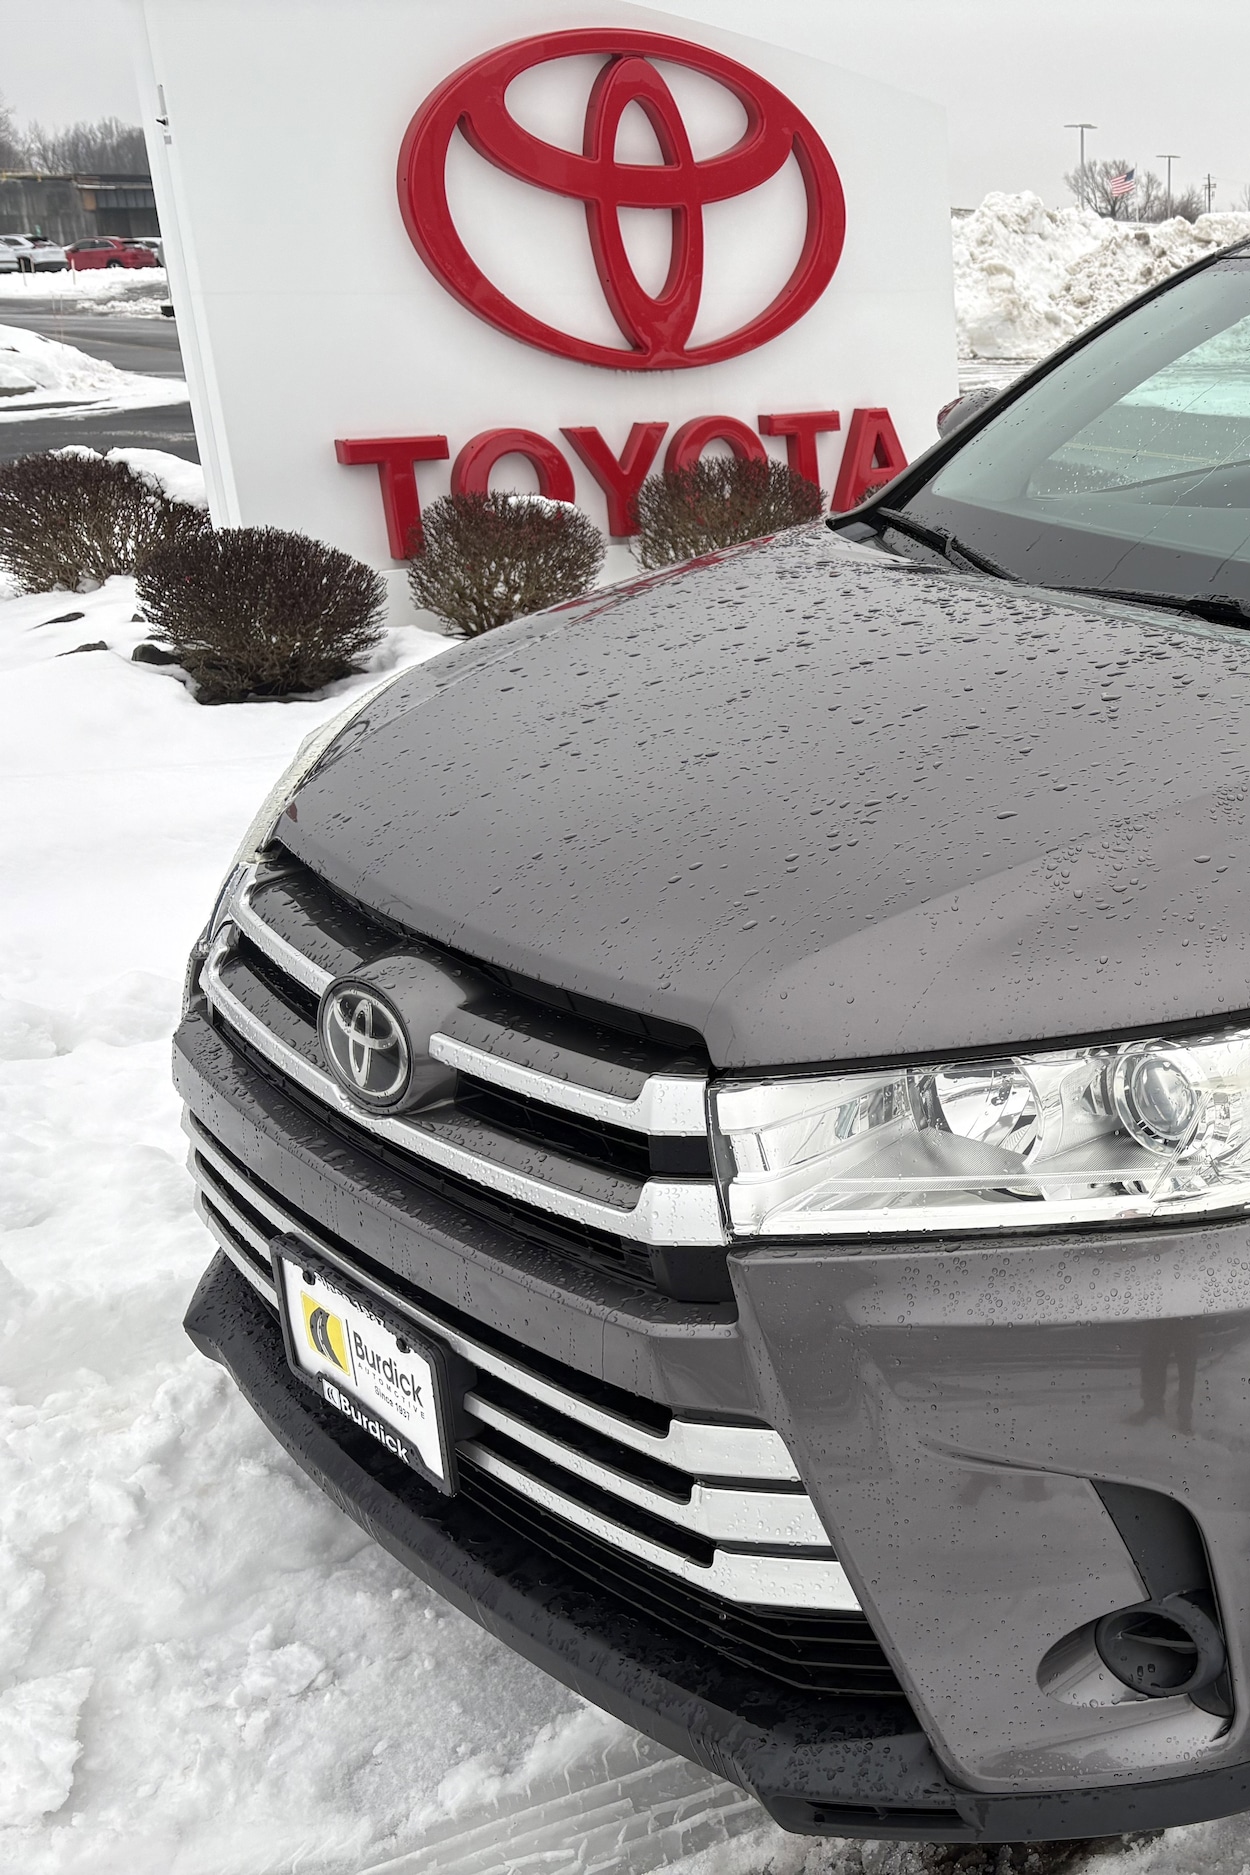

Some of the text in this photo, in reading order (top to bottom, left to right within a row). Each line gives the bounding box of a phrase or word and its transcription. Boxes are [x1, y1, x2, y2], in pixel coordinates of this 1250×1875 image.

[353, 1330, 424, 1408] Burdick
[374, 1385, 394, 1408] Since
[340, 1393, 409, 1464] Burdick
